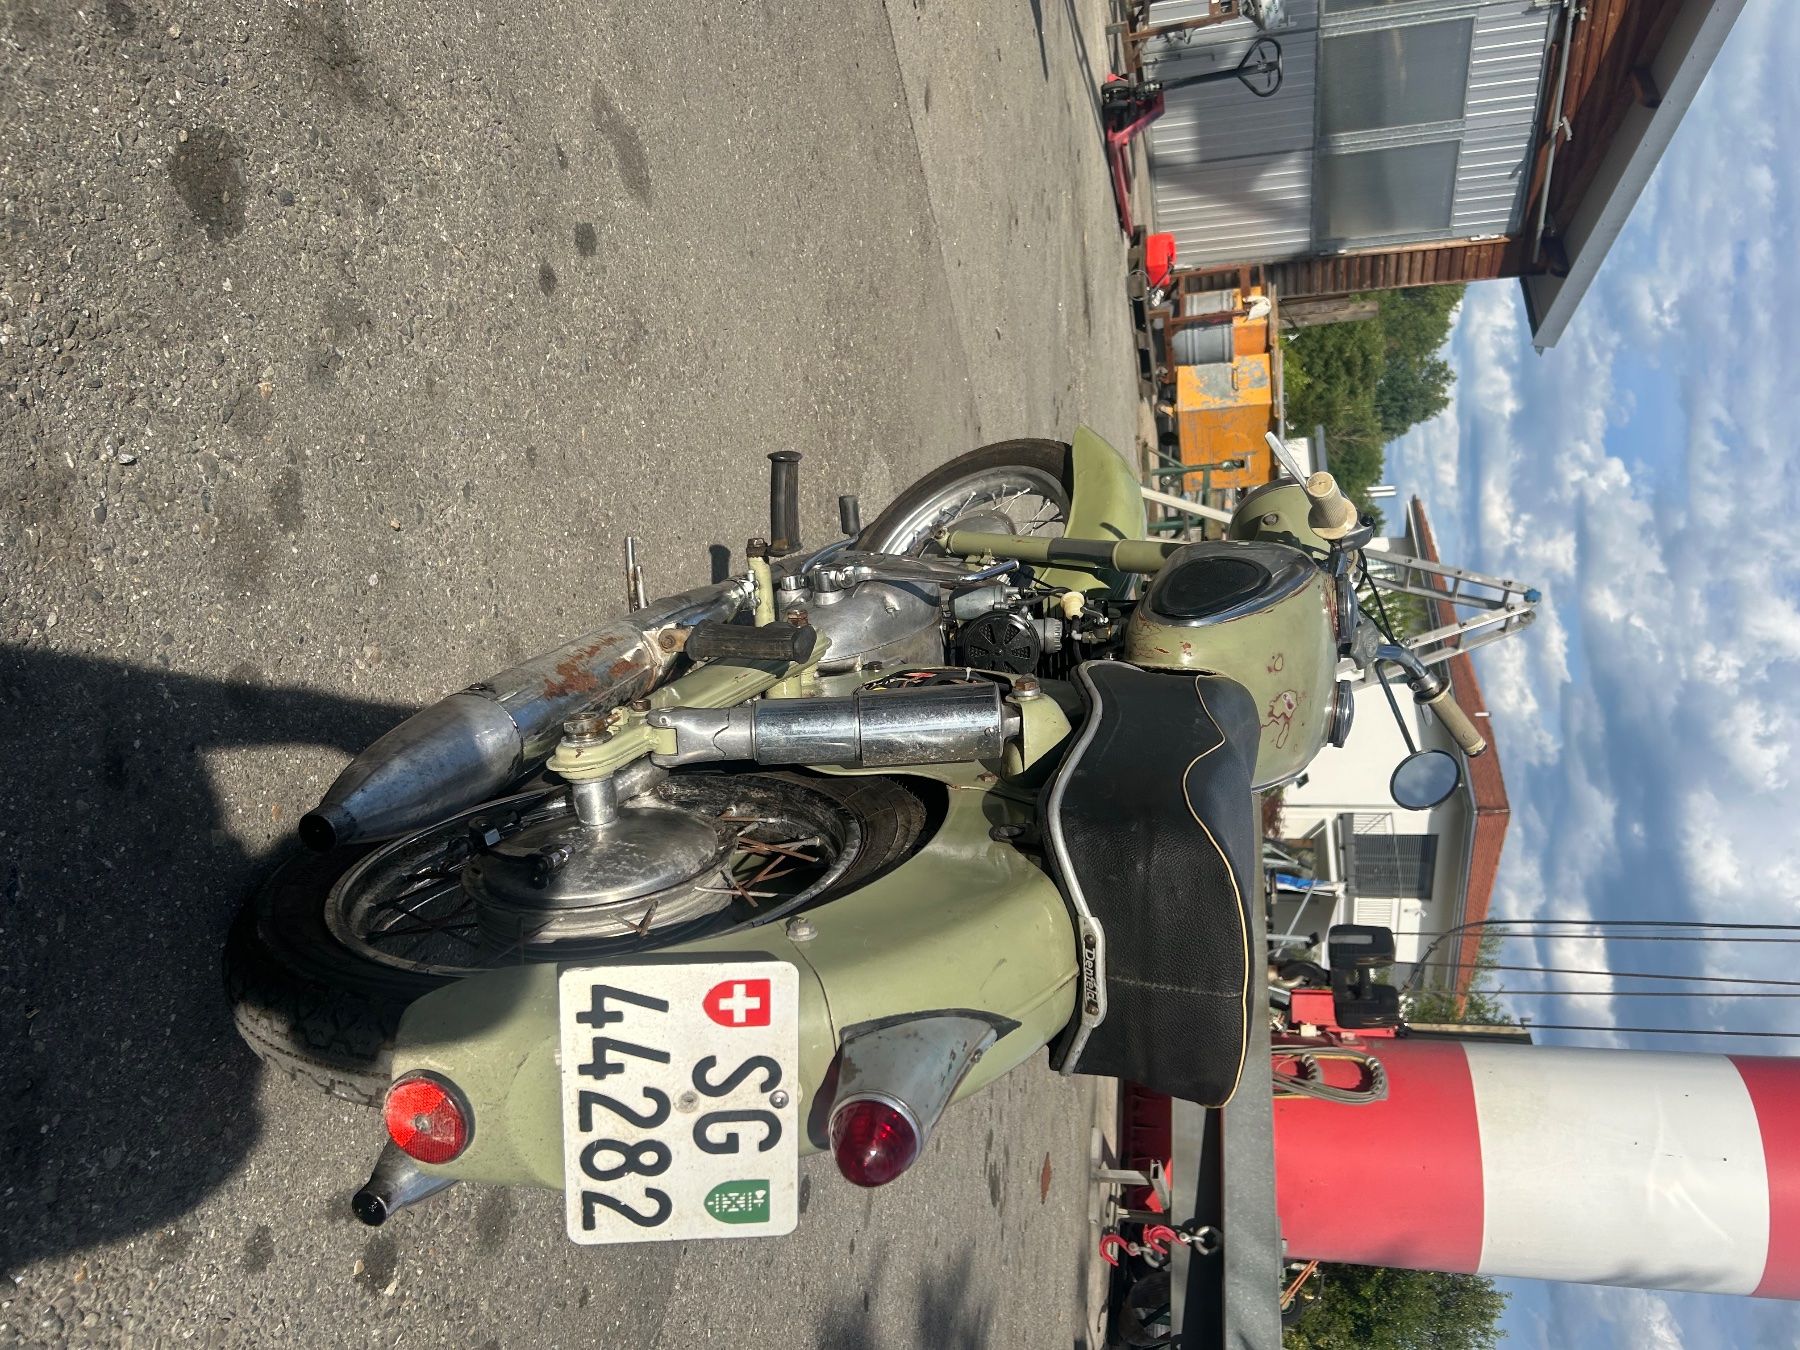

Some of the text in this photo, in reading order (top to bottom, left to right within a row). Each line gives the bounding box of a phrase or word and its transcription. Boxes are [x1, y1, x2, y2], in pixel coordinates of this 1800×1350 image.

[1085, 949, 1098, 1001] Denfeld
[576, 984, 672, 1231] 44282
[692, 1055, 783, 1155] SG
